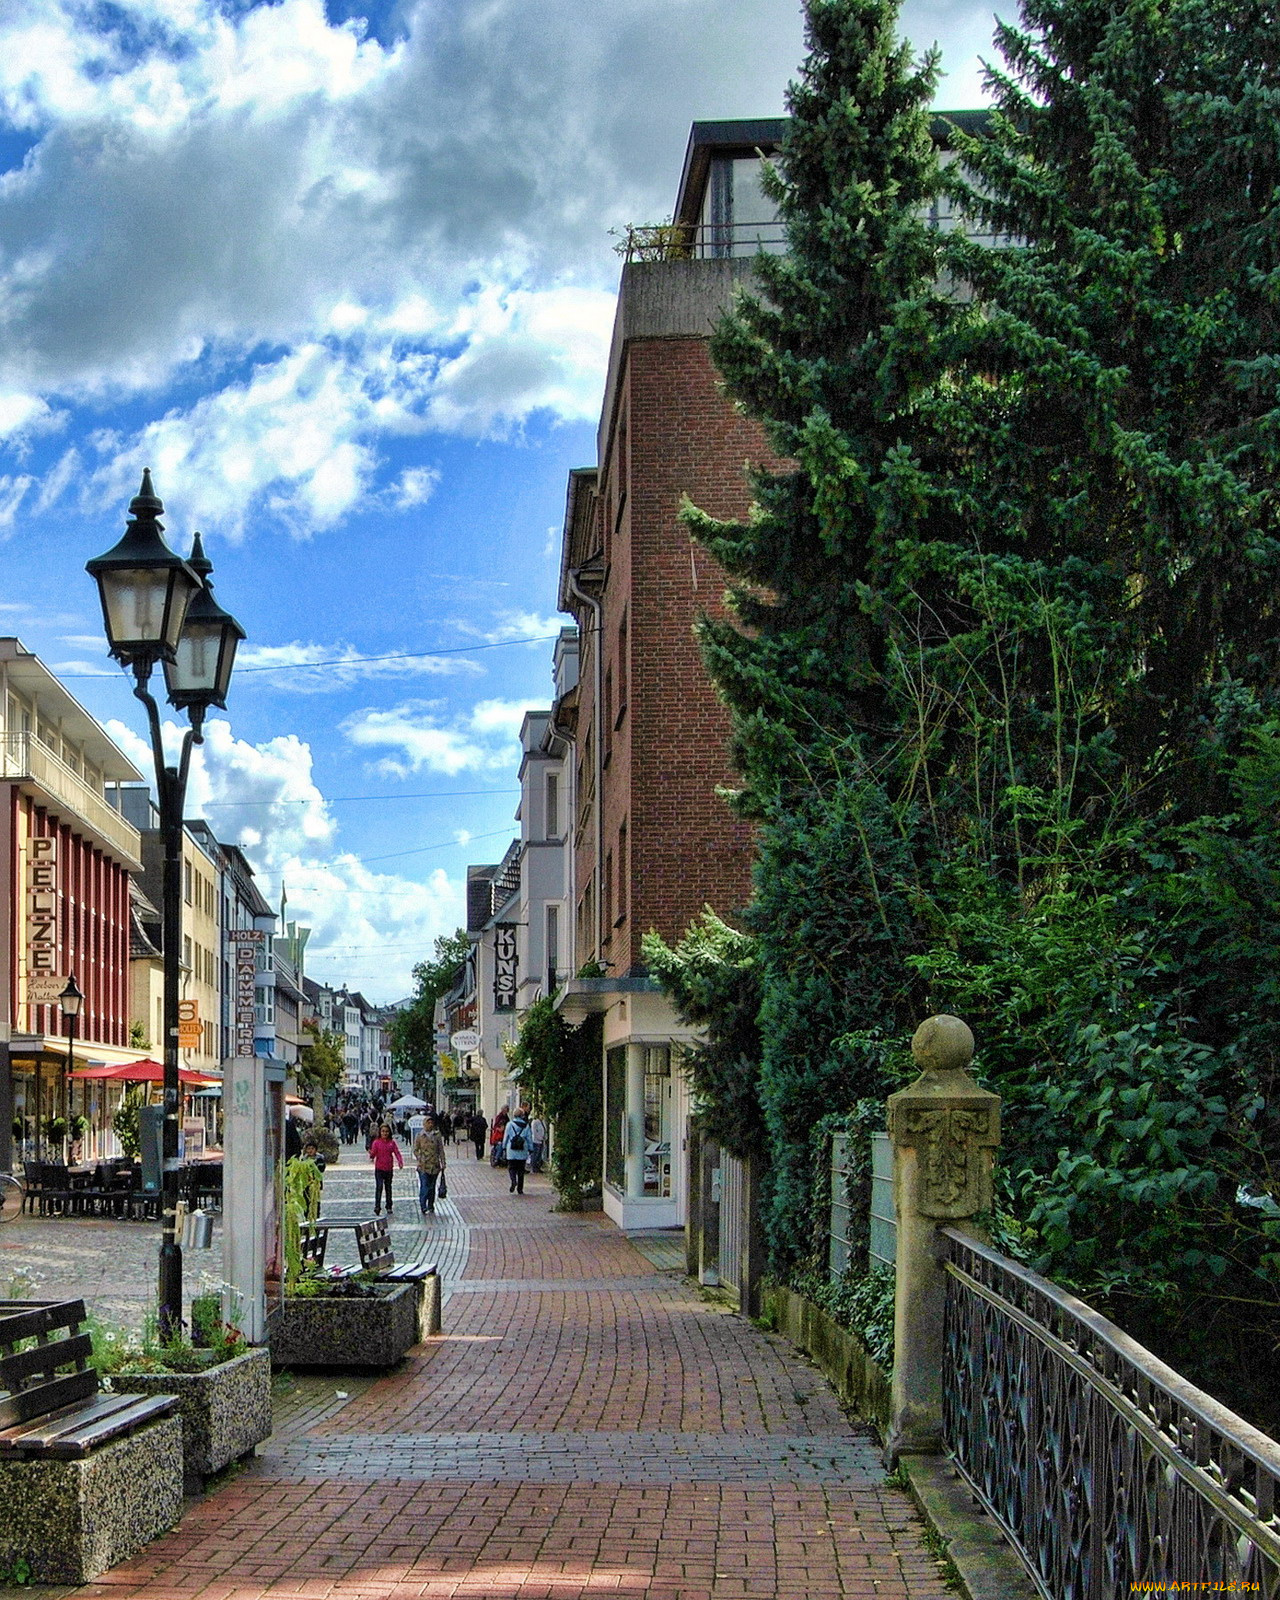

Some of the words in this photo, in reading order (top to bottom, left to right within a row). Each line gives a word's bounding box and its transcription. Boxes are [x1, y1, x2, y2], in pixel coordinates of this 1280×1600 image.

[32, 839, 52, 969] PELZE
[232, 931, 261, 941] HOLZ
[239, 948, 254, 1055] DAMMERS
[497, 929, 516, 1006] KUNST
